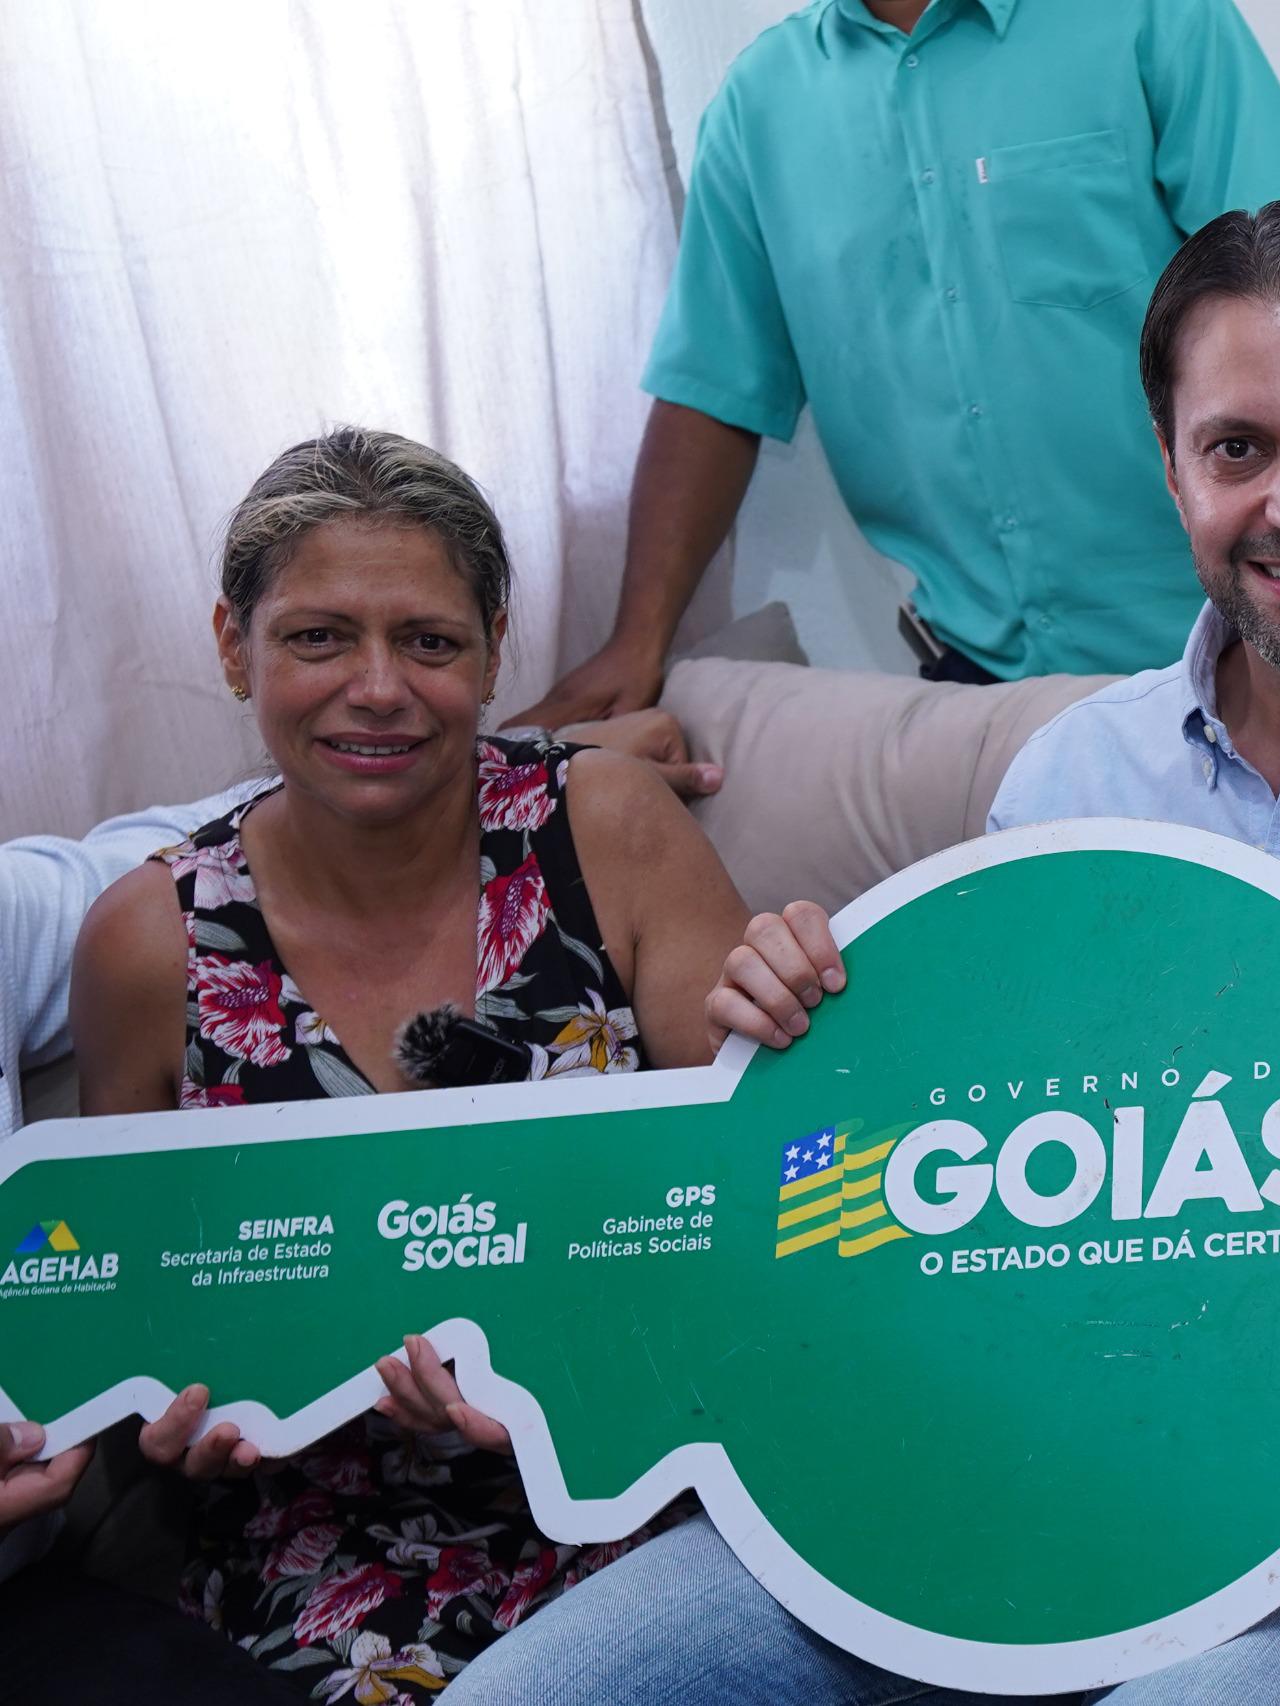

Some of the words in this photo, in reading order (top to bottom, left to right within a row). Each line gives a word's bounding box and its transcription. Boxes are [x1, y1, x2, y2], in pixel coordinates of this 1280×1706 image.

[929, 1068, 1181, 1106] GOVERNO
[665, 1184, 717, 1208] GPS
[238, 1215, 334, 1241] SEINFRA
[602, 1215, 684, 1235] Gabinete
[688, 1211, 714, 1230] de
[161, 1249, 242, 1268] Secretaria
[247, 1244, 269, 1262] de
[274, 1240, 332, 1259] Estado
[402, 1223, 528, 1272] social
[568, 1238, 642, 1262] Políticas
[647, 1234, 713, 1254] Sociais
[919, 1251, 944, 1276] O
[951, 1243, 1071, 1274] ESTADO
[1078, 1238, 1144, 1266] QUE
[1152, 1228, 1197, 1261] DÁ
[0, 1252, 119, 1286] AGEHAB
[191, 1269, 213, 1287] da
[218, 1264, 329, 1285] Infraestrutura
[30, 1284, 60, 1296] Goiana
[61, 1282, 73, 1294] de
[73, 1280, 117, 1293] Habitação
